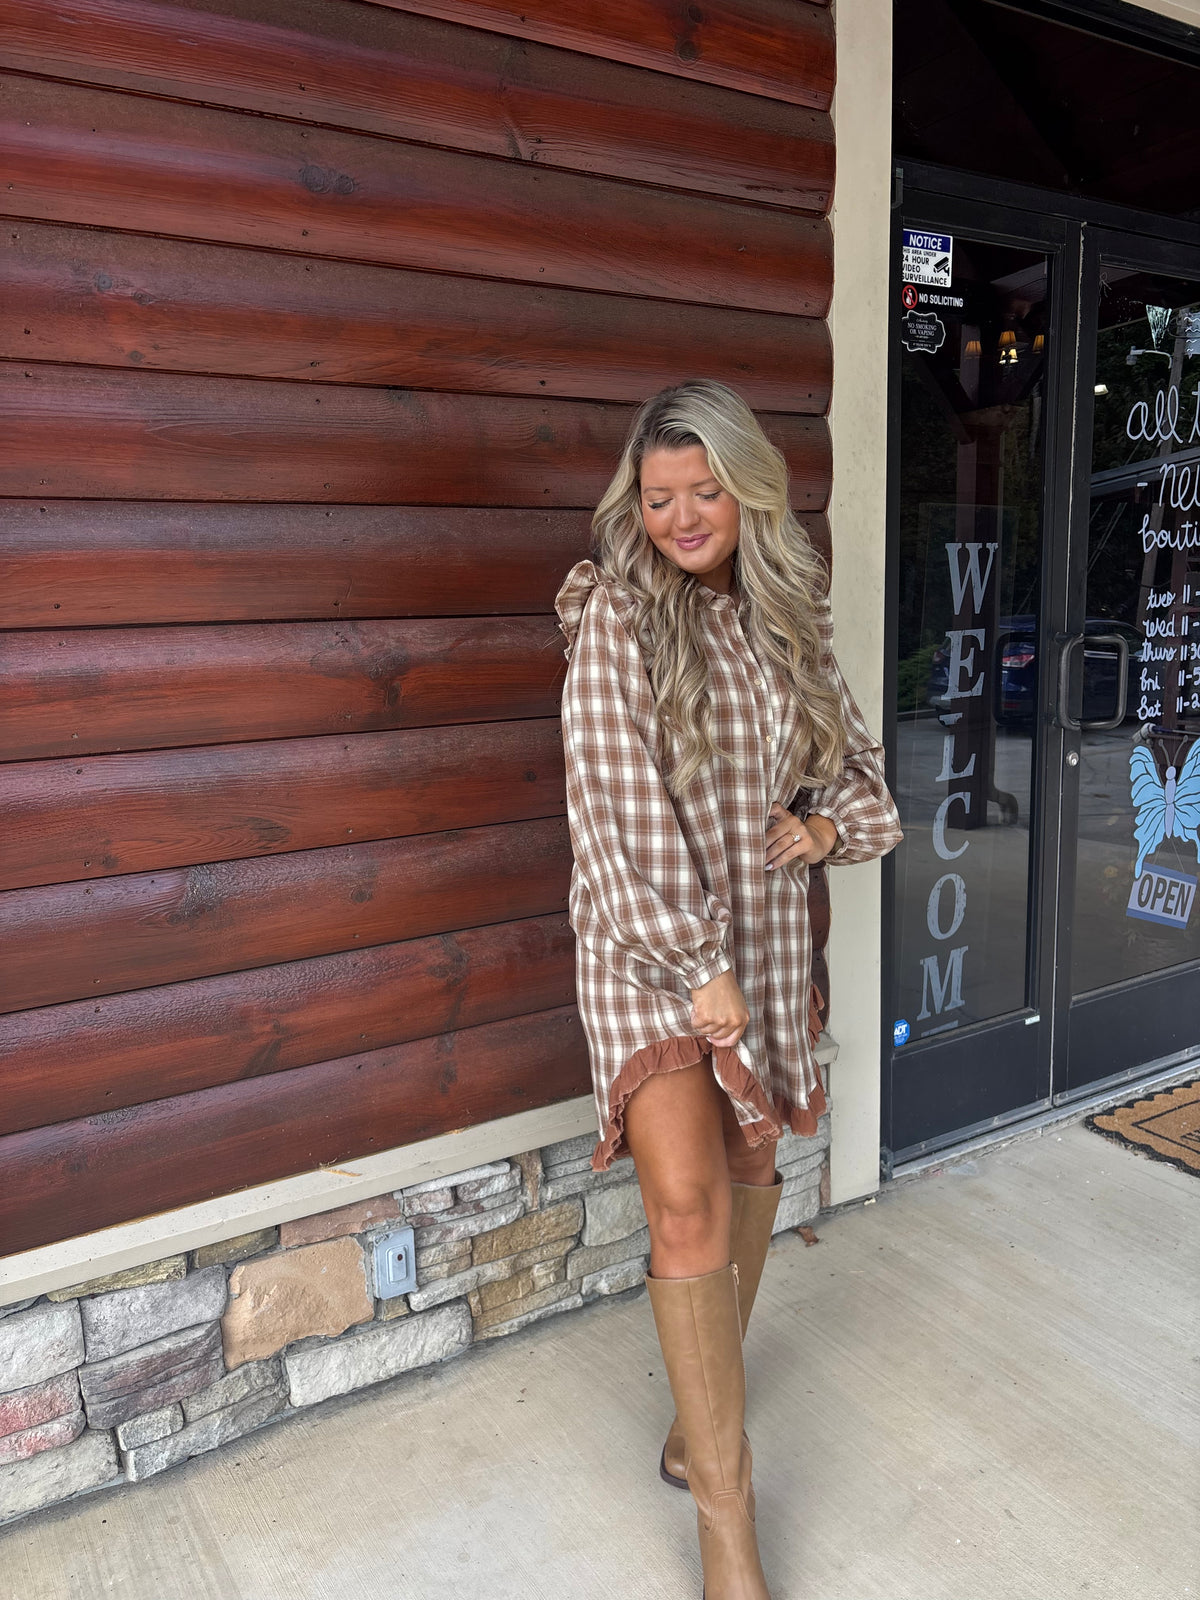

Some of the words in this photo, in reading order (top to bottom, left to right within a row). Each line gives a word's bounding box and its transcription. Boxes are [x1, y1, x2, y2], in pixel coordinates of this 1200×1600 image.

[909, 234, 942, 250] NOTICE
[911, 256, 930, 265] HOUR
[918, 293, 928, 304] NO
[929, 294, 964, 307] SOLICITING
[915, 323, 937, 331] SMOKING
[1126, 384, 1183, 444] all
[917, 542, 999, 1037] WELCOM
[1137, 873, 1192, 918] OPEN
[894, 1024, 908, 1036] ADT
